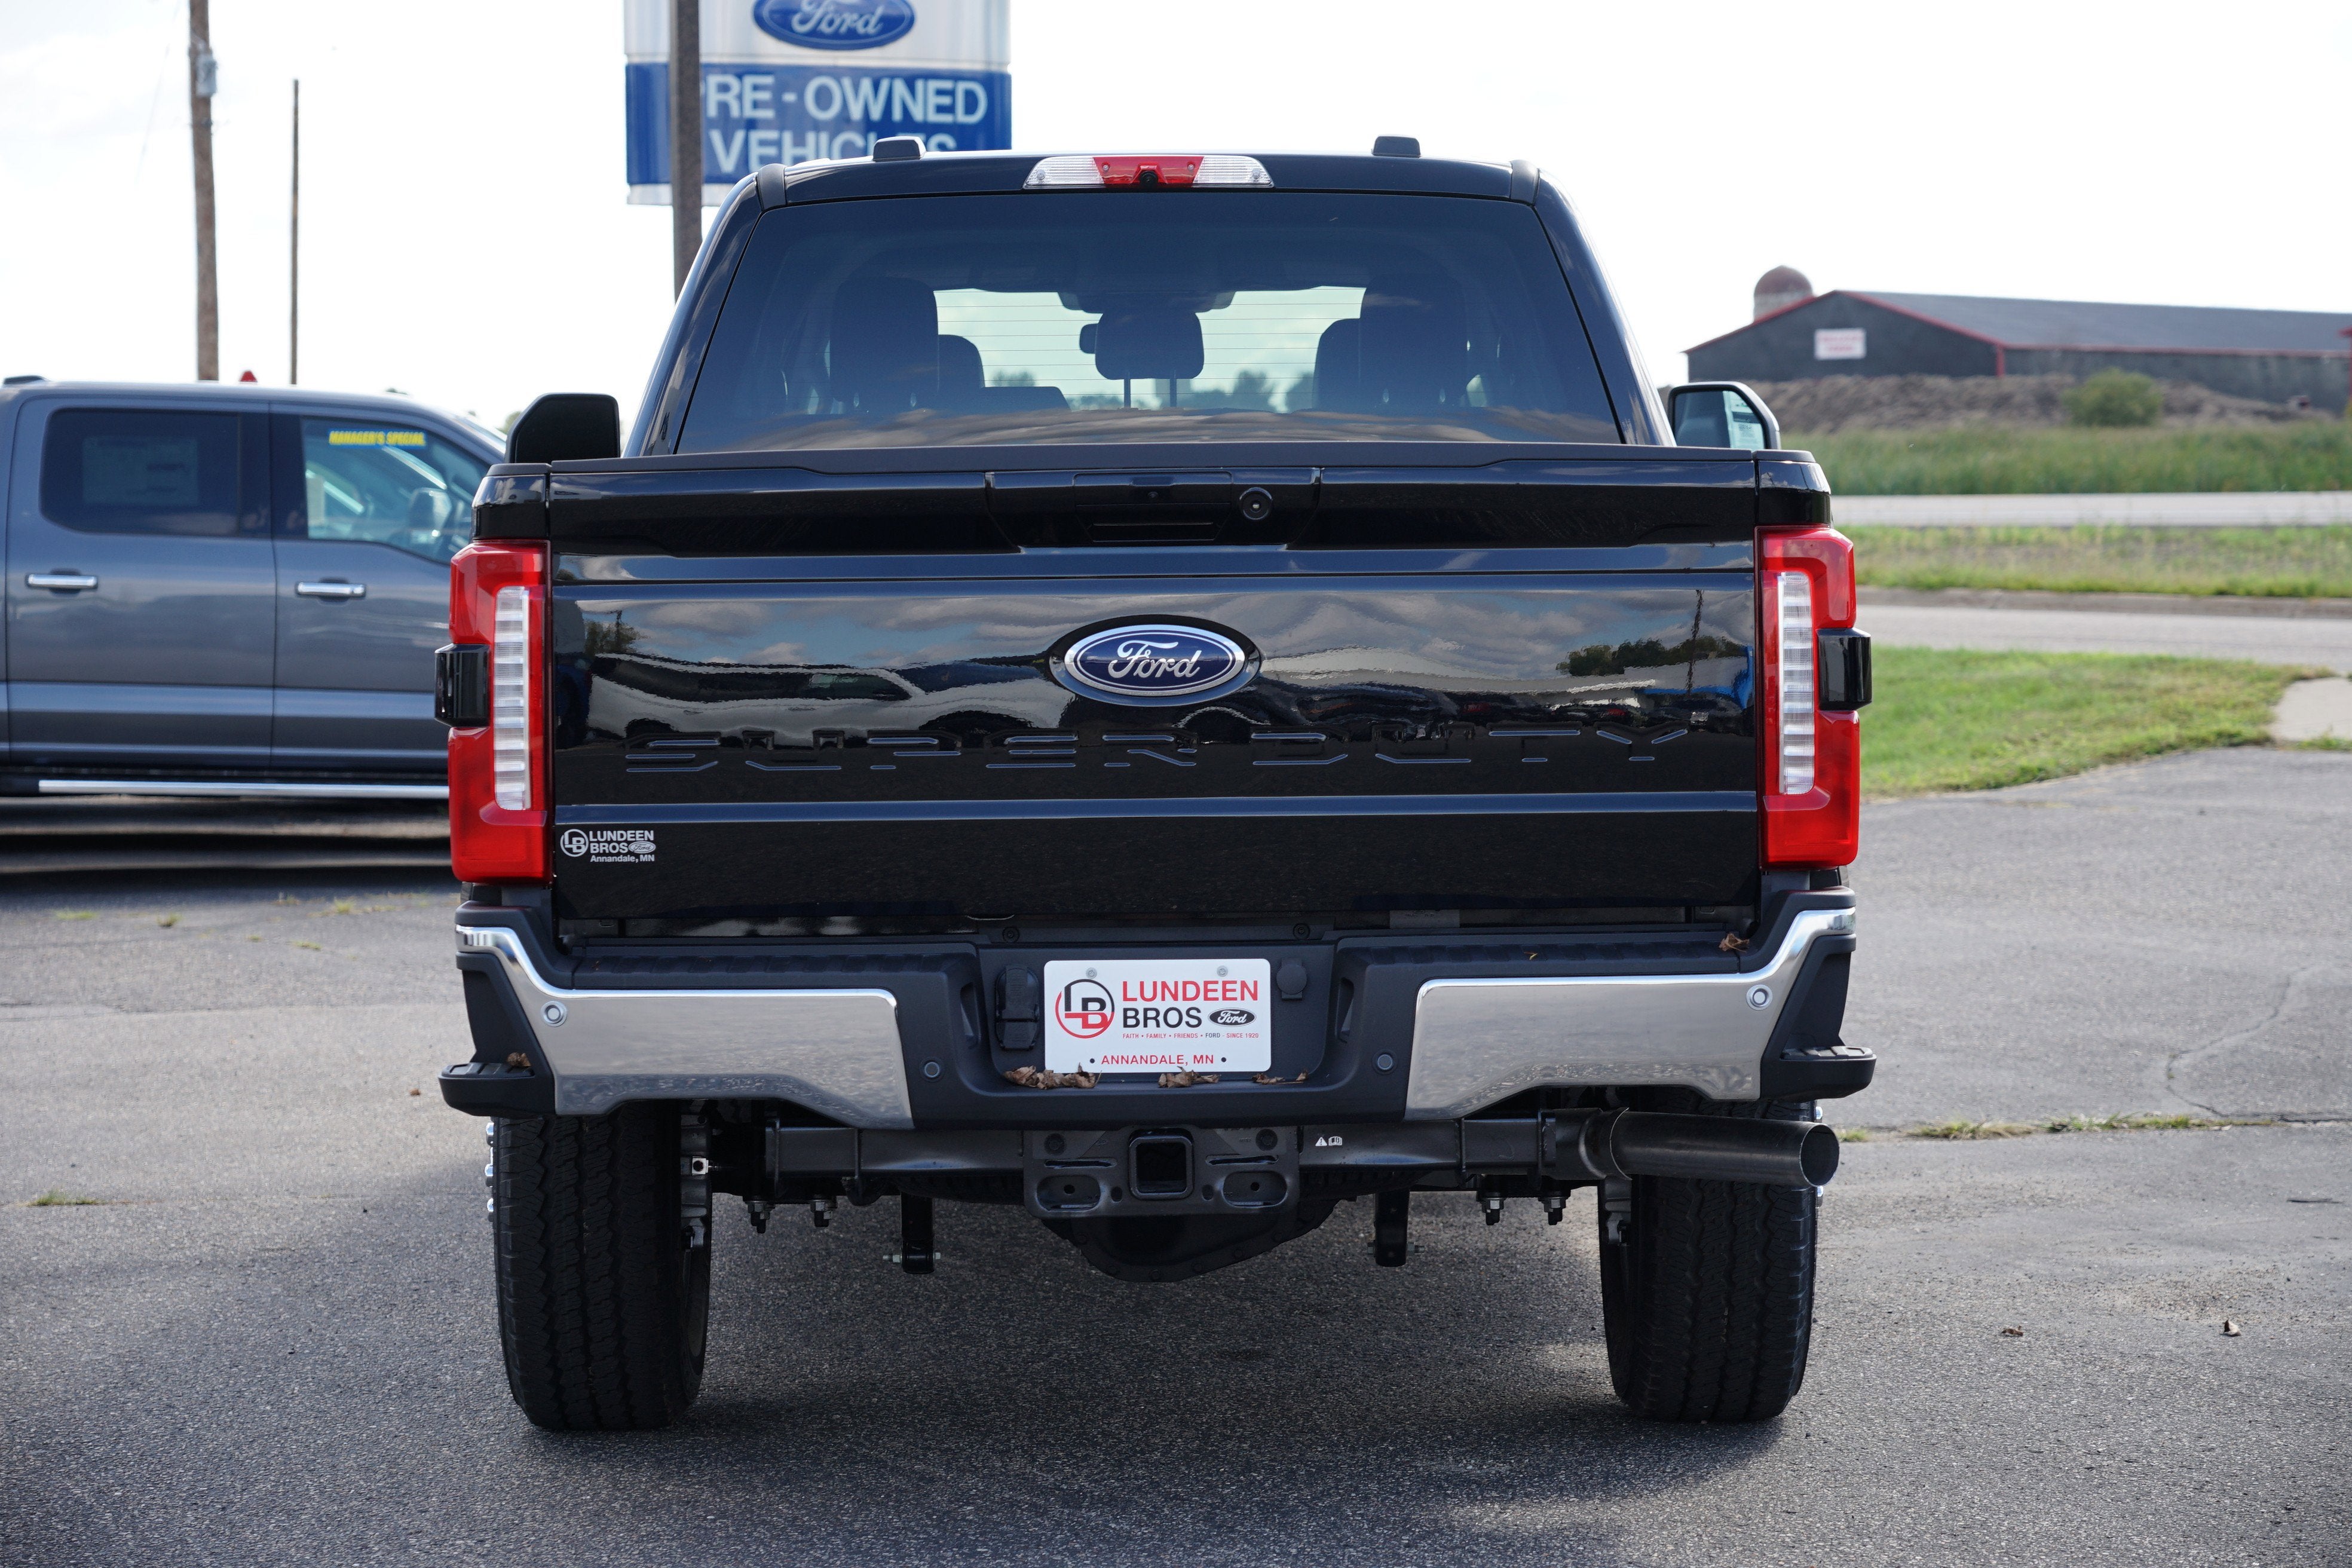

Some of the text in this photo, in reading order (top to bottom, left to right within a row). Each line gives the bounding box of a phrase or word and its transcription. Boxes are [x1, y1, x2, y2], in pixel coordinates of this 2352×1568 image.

[791, 0, 884, 34] Ford
[701, 74, 988, 124] RE-OWNED
[329, 431, 426, 446] MANAGER'S SPECIAL
[1108, 640, 1202, 678] Ford
[625, 721, 1690, 773] SUPER DUTY
[589, 830, 654, 841] LUNDEEN
[590, 843, 628, 853] BROS
[590, 855, 638, 863] Annandale,
[1122, 980, 1258, 1002] LUNDEEN
[1122, 1007, 1247, 1028] BROS Ford
[1101, 1055, 1214, 1066] ANNANDALE, MN
